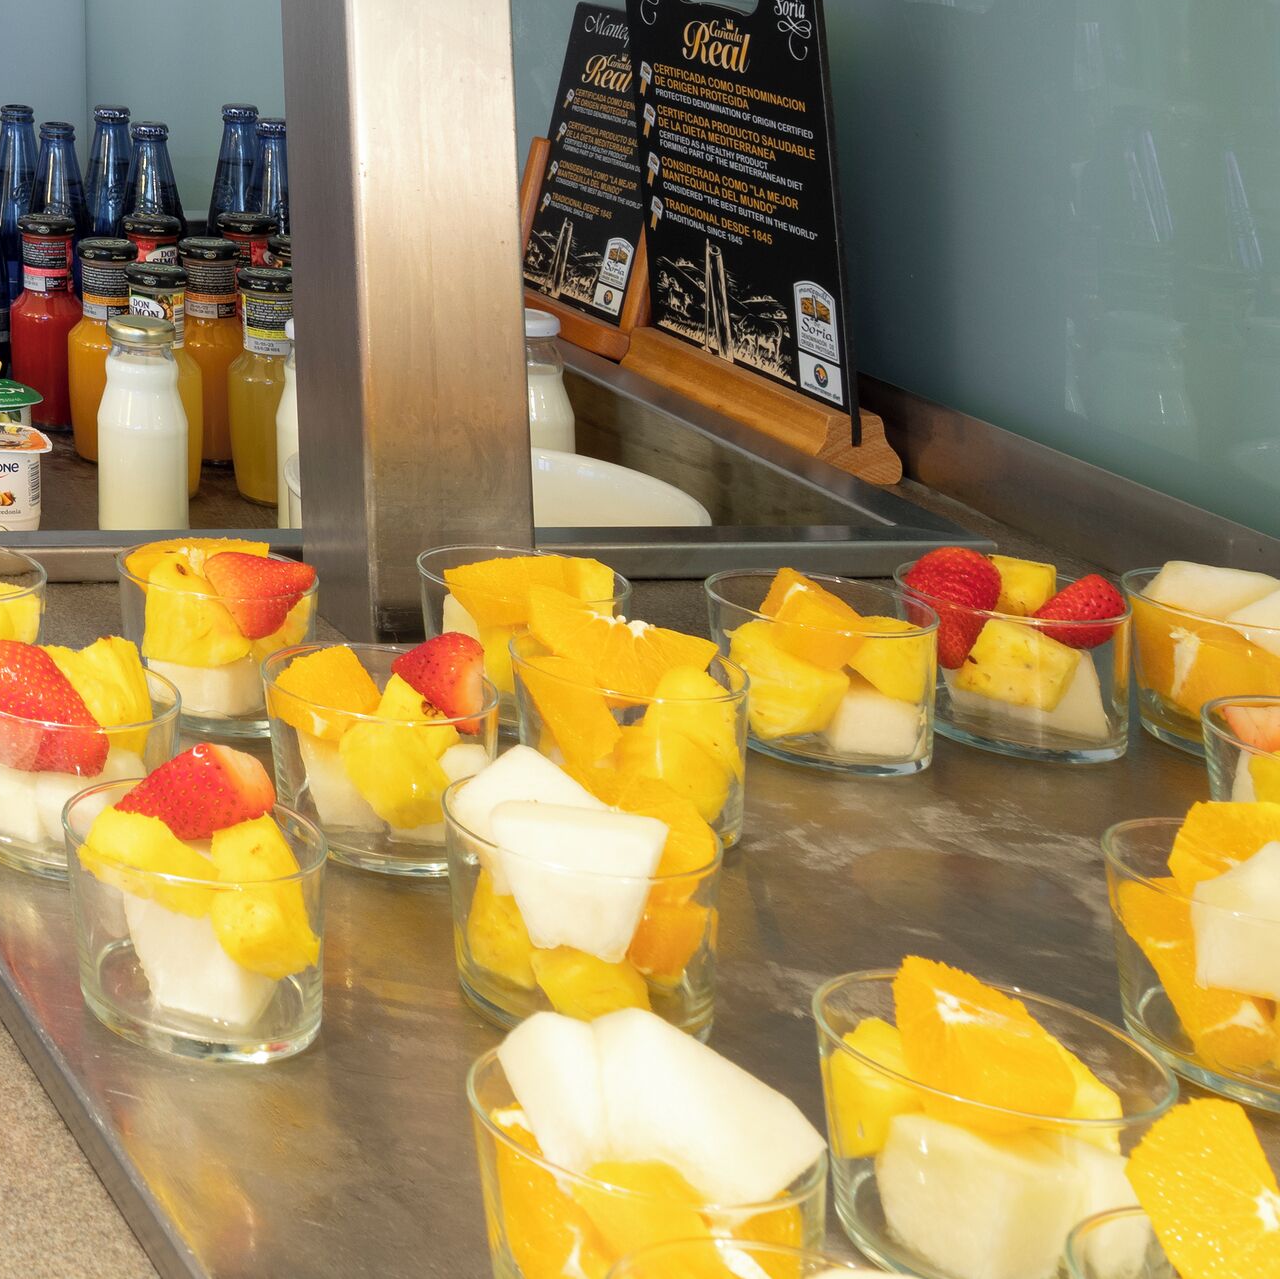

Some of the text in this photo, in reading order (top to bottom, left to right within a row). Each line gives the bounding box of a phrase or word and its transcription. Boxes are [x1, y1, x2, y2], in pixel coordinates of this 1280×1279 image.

[682, 20, 750, 74] Real
[709, 20, 743, 43] Cañada
[581, 54, 632, 93] Real
[653, 62, 806, 112] CERTIFICADA COMO DENOMINACION
[573, 97, 628, 117] DE ORIGEN PROTEGIDA
[576, 88, 622, 107] CERTIFICADA COMO
[654, 75, 749, 110] DE ORIGEN PROTEGIDA
[655, 88, 814, 140] PROTECTED DENOMINATION OF ORIGIN CERTIFIED
[566, 129, 573, 137] DE
[580, 133, 594, 143] DIETA
[594, 138, 633, 155] MEDITERRANEA
[568, 121, 599, 135] CERTIFICADA
[600, 128, 627, 143] PRODUCTO
[657, 104, 816, 160] CERTIFICADA PRODUCTO SALUDABLE
[658, 116, 777, 161] DE LA DIETA MEDITERRANEA
[659, 130, 768, 170] CERTIFIED AS A HEALTHY PRODUCT
[660, 139, 803, 191] FORMING PART OF THE MEDITERRANEAN DIET
[557, 169, 590, 185] MANTEQUILLA
[591, 179, 600, 188] DEL
[560, 160, 593, 176] CONSIDERADA
[593, 170, 608, 181] COMO
[618, 178, 637, 191] MEJOR
[661, 156, 799, 210] CONSIDERADA COMO "LA MEJOR
[662, 169, 777, 215] MANTEQUILLA DEL MUNDO"
[552, 192, 613, 220] TRADICIONAL DESDE 1845
[663, 181, 818, 240] CONSIDERED "THE BEST BUTTER IN THE WORLD"
[664, 197, 773, 245] TRADICIONAL DESDE 1845
[665, 210, 743, 245] TRADITIONAL SINCE 1845
[160, 250, 176, 258] DON
[133, 298, 150, 309] DON
[801, 317, 833, 341] Soria
